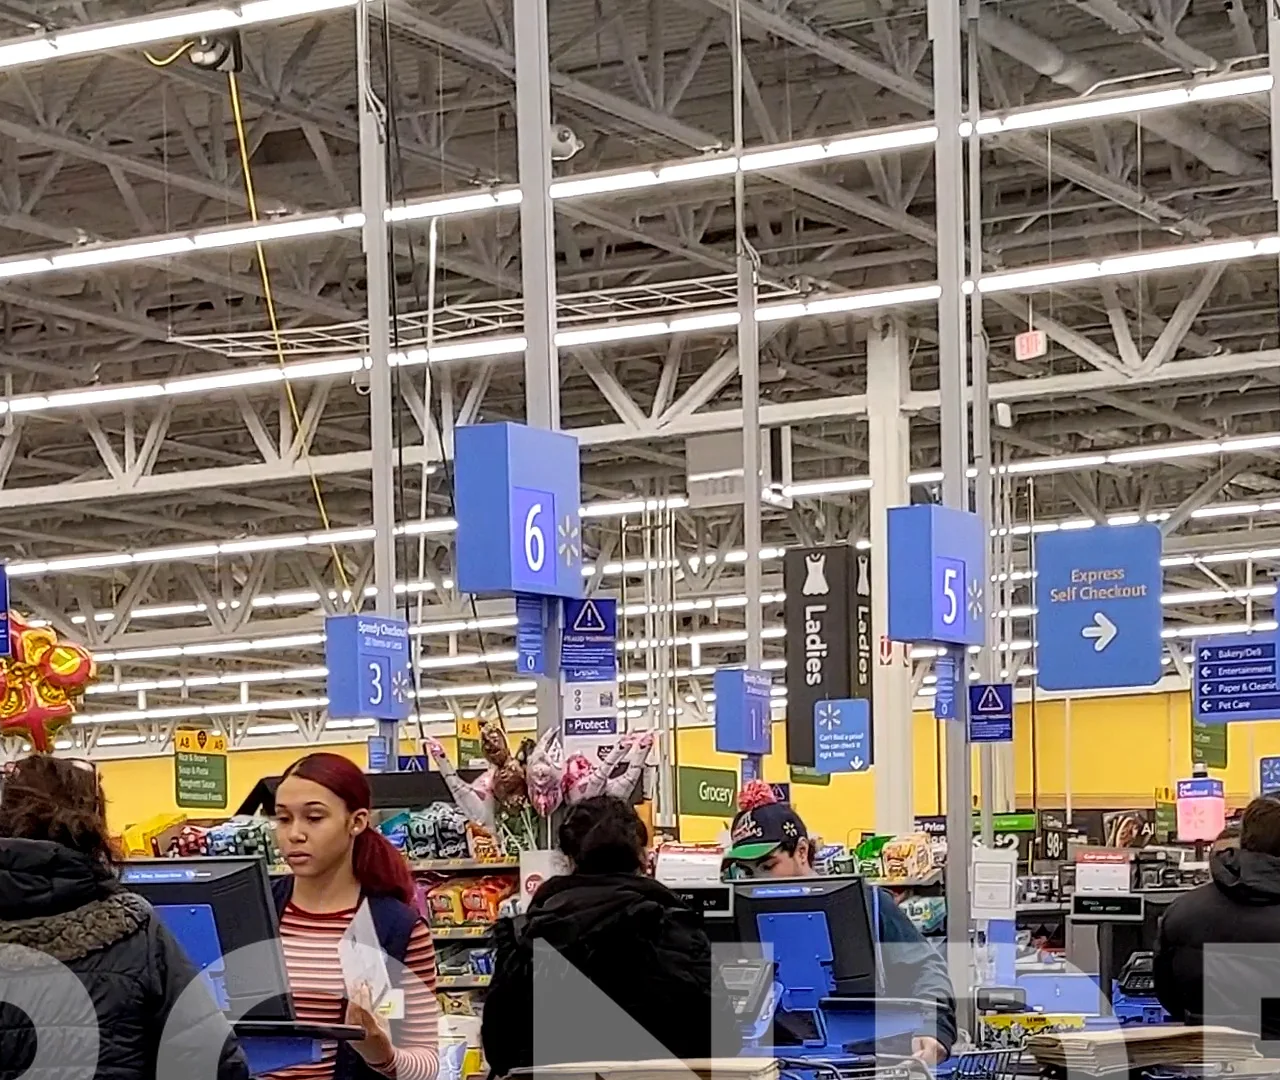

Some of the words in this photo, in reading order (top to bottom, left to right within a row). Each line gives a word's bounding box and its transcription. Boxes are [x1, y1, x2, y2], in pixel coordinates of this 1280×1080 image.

[525, 503, 545, 572] 6
[1071, 568, 1125, 584] Express
[943, 569, 957, 624] 5
[1050, 587, 1077, 602] Self
[1080, 584, 1147, 600] Checkout
[805, 604, 828, 686] Ladies
[857, 606, 870, 685] Ladies
[1218, 648, 1262, 659] Bakery/Deli
[1218, 665, 1273, 676] Entertainment
[370, 662, 383, 705] 3
[1218, 684, 1240, 693] Paper
[1249, 681, 1277, 691] Cleanin
[1218, 701, 1231, 710] Pet
[1232, 700, 1250, 709] Care
[574, 719, 610, 731] Protect
[751, 708, 756, 740] 1
[180, 737, 190, 748] A8
[699, 782, 734, 807] Grocery
[924, 823, 946, 832] Price
